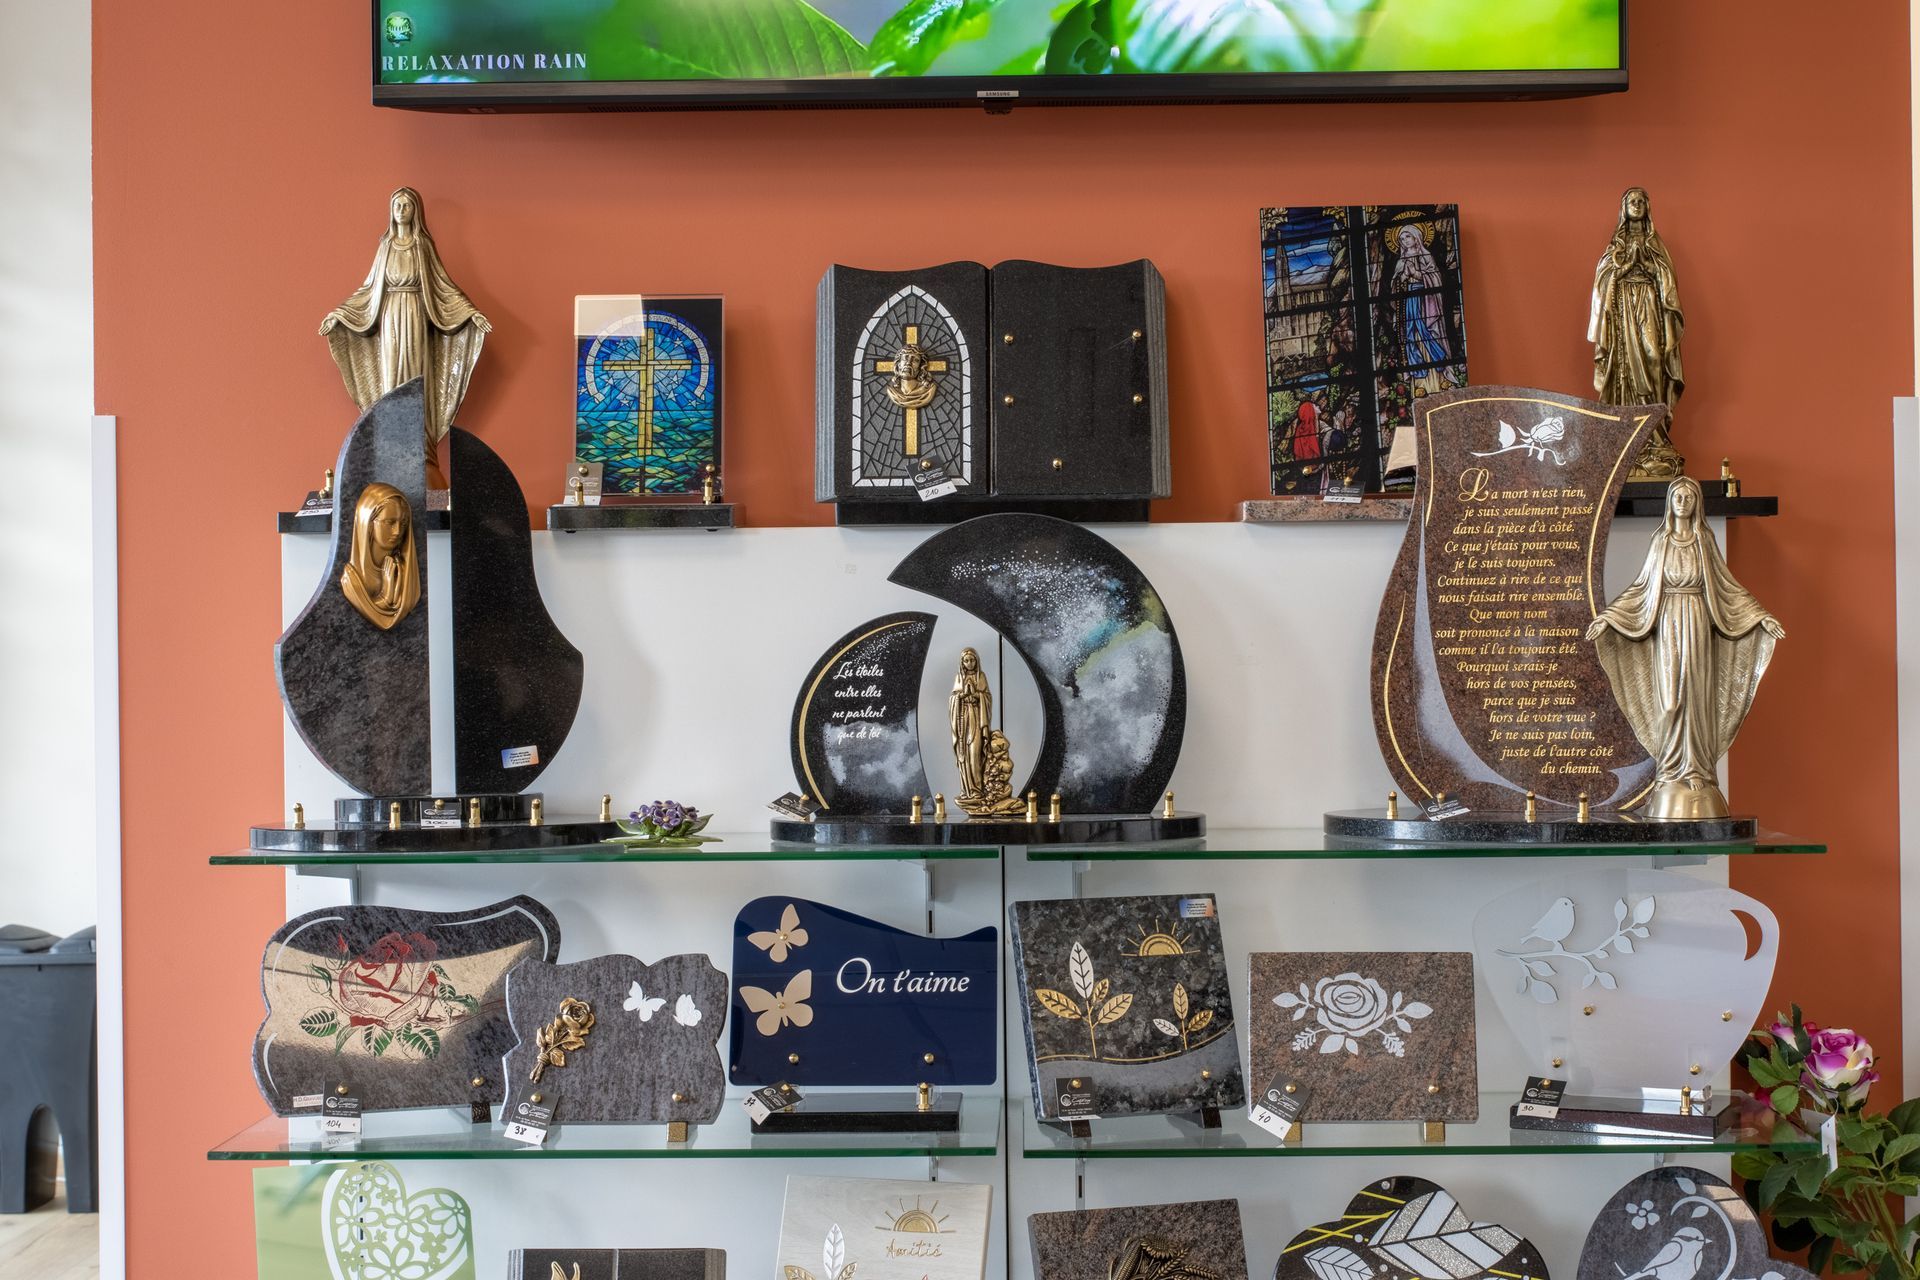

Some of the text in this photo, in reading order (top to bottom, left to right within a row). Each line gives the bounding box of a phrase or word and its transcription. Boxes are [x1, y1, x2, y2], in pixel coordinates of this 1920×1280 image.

[382, 53, 587, 71] RELAXATION RAIN
[1459, 468, 1586, 501] La mort n'est rien,
[1463, 504, 1592, 521] je suis seulement passé
[1453, 523, 1479, 534] dans
[1484, 522, 1494, 534] la
[1497, 522, 1525, 537] pièce
[1550, 521, 1575, 532] côté.
[1445, 539, 1580, 554] Ce que j'étais pour vous,
[1453, 557, 1555, 572] je le suis toujours.
[1438, 575, 1496, 588] Continuez
[1500, 574, 1506, 584] à
[1511, 575, 1529, 584] rire
[1533, 574, 1546, 584] de
[1564, 575, 1582, 586] qui
[1439, 590, 1584, 606] nous faisait rire ensemble.
[1470, 609, 1547, 623] Que mon nom
[1435, 625, 1579, 640] soit prononcé à la maison
[1439, 646, 1476, 655] comme
[1480, 644, 1490, 656] il
[1509, 644, 1555, 657] toujours
[1559, 643, 1578, 654] été.
[833, 662, 884, 679] Les étoiles
[1457, 661, 1558, 673] Pourquoi serais-je
[835, 686, 882, 697] entre elles
[1467, 678, 1577, 691] hors de vos pensées,
[1484, 696, 1575, 709] parce que je suis
[833, 706, 886, 722] ne parlent
[1490, 712, 1512, 723] hors
[1517, 712, 1529, 722] de
[1533, 713, 1561, 722] votre
[1567, 714, 1586, 722] vue
[837, 727, 880, 745] que de toi
[1489, 728, 1595, 742] Je ne suis pas loin,
[1501, 745, 1613, 759] juste de l'autre côté
[1541, 762, 1601, 774] du chemin.
[836, 957, 970, 993] On t'aime
